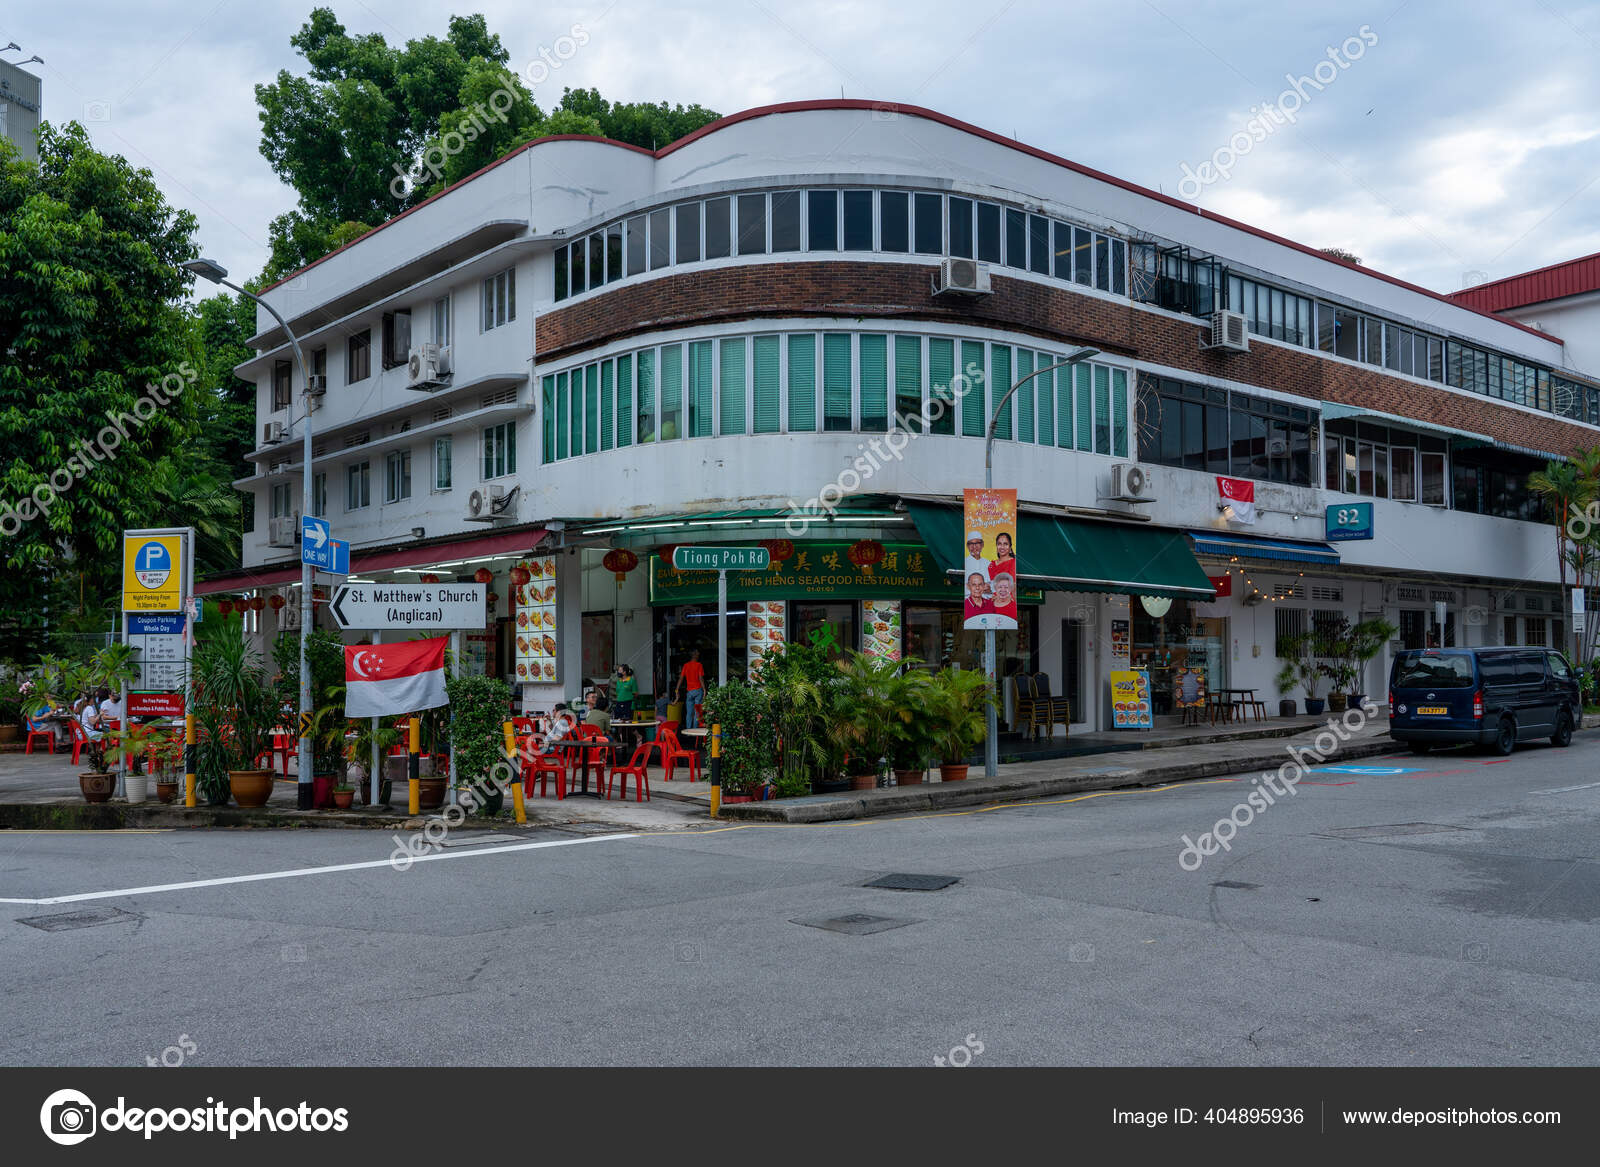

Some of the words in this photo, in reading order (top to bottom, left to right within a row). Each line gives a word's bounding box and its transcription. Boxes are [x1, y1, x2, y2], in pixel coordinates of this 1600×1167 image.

[1338, 509, 1359, 524] 82
[146, 547, 163, 568] P
[304, 550, 315, 561] ONE
[317, 551, 327, 562] WAY
[683, 550, 718, 567] Tiong
[723, 550, 744, 563] Poh
[750, 551, 763, 563] Rd
[739, 577, 762, 587] TING
[765, 576, 794, 586] HENG
[798, 575, 852, 585] SEAFOOD
[855, 576, 925, 587] RESTAURANT
[351, 591, 367, 602] St.
[374, 590, 432, 602] Matthew's
[438, 590, 478, 602] Church
[387, 608, 443, 624] (Anglican)
